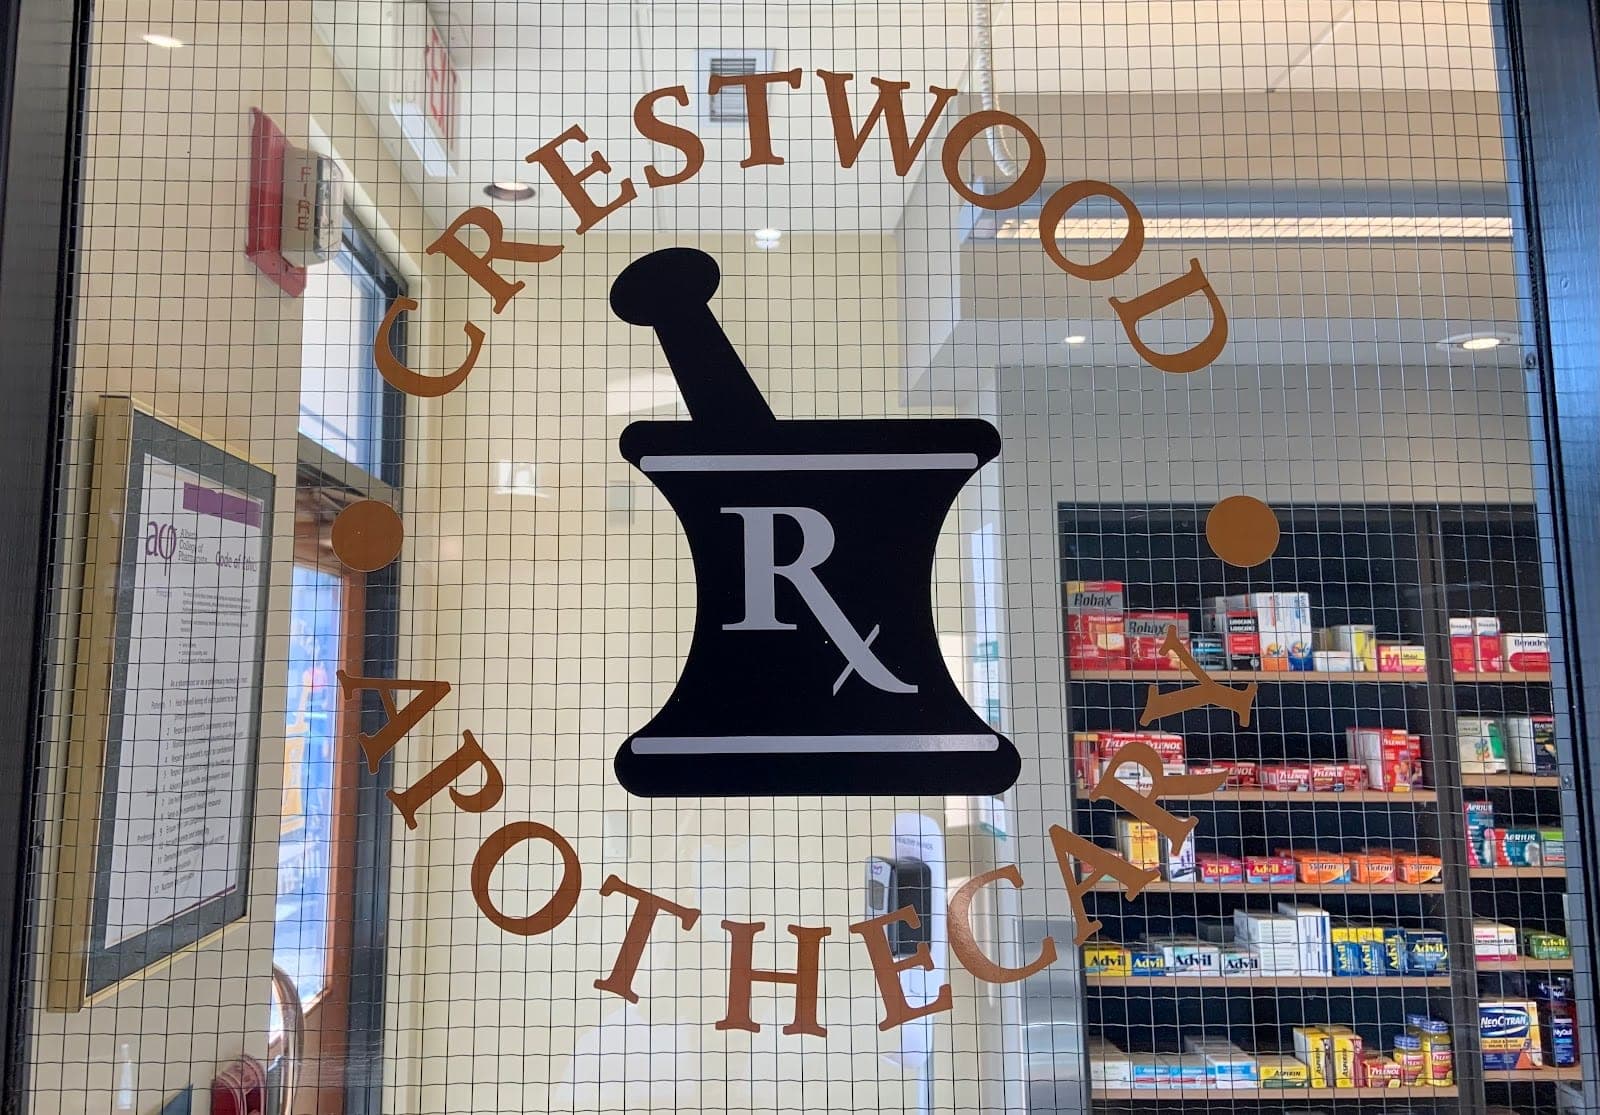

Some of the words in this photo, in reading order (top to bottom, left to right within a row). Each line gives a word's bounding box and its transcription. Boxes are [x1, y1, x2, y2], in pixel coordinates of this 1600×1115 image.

[296, 166, 313, 231] FIRE
[374, 68, 1230, 397] CRESTWOOD
[1074, 593, 1113, 608] Robax
[1128, 621, 1168, 636] Robax
[336, 634, 1258, 1037] APOTHECARY
[1411, 943, 1444, 953] Advil
[1090, 953, 1126, 966] Advil
[1133, 957, 1164, 969] Advil
[1174, 952, 1212, 966] Advil
[1226, 957, 1258, 969] Advil
